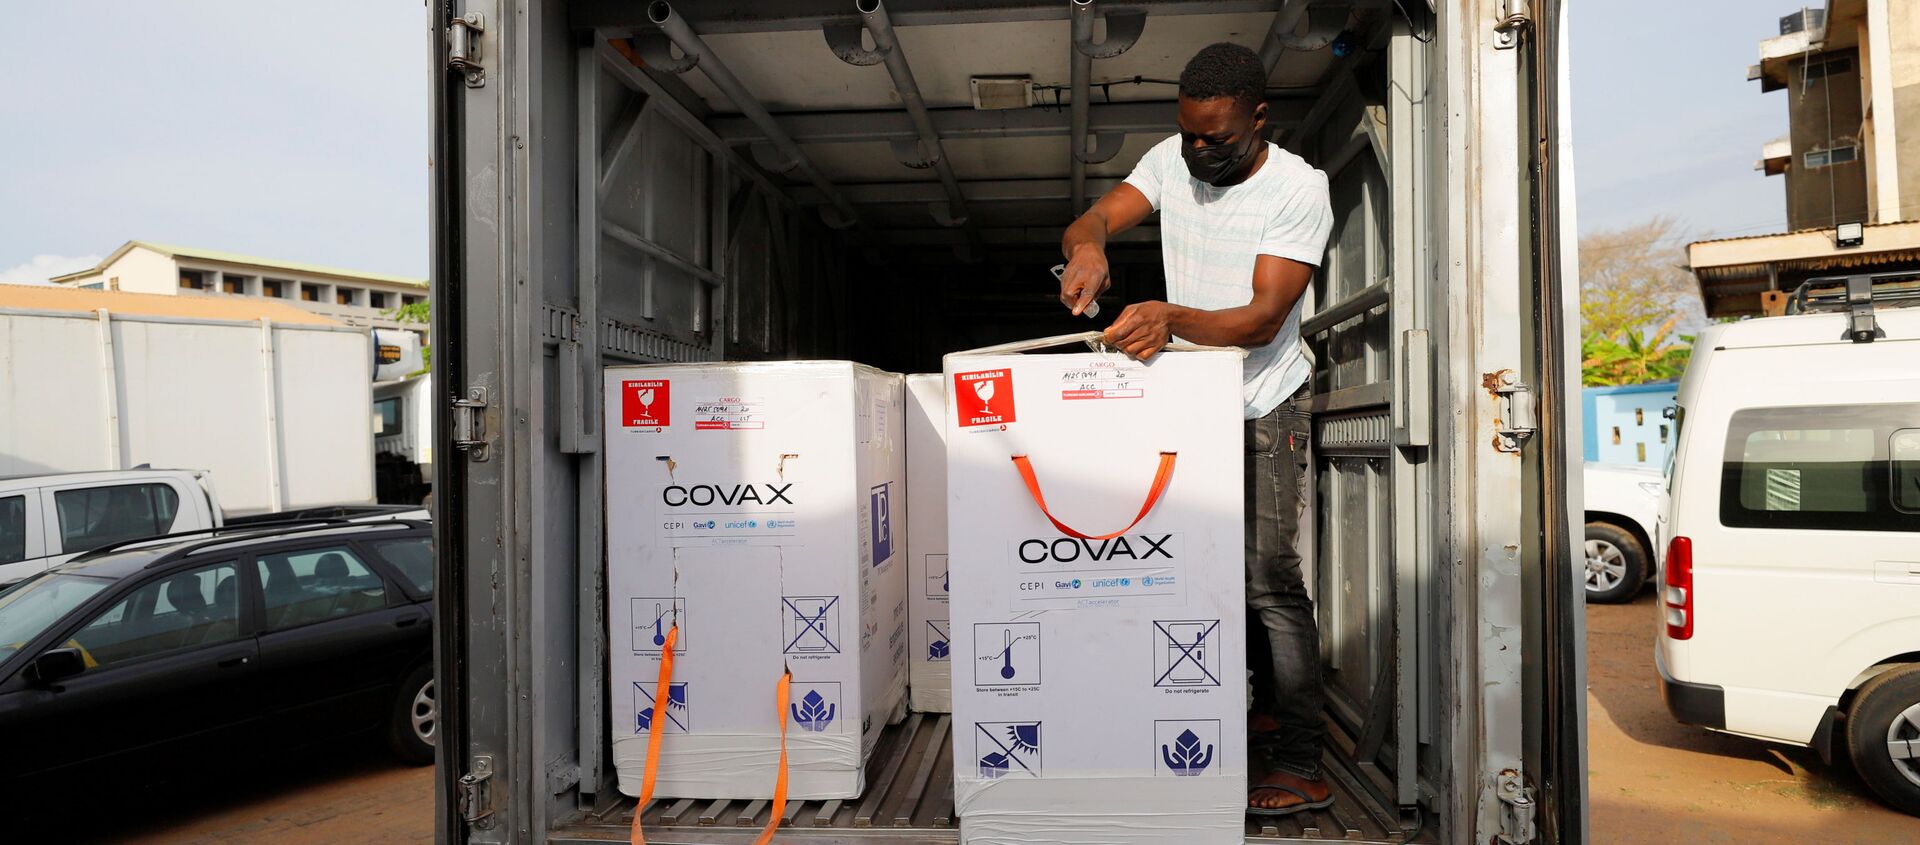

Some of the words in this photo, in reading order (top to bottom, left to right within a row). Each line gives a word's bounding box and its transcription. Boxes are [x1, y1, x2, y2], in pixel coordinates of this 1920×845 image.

[971, 415, 1002, 424] FRAGILE
[663, 484, 794, 506] COVAX
[725, 520, 747, 528] unicef
[1019, 534, 1174, 564] COVAX
[1020, 582, 1044, 591] CEPI
[1092, 578, 1119, 588] unicef
